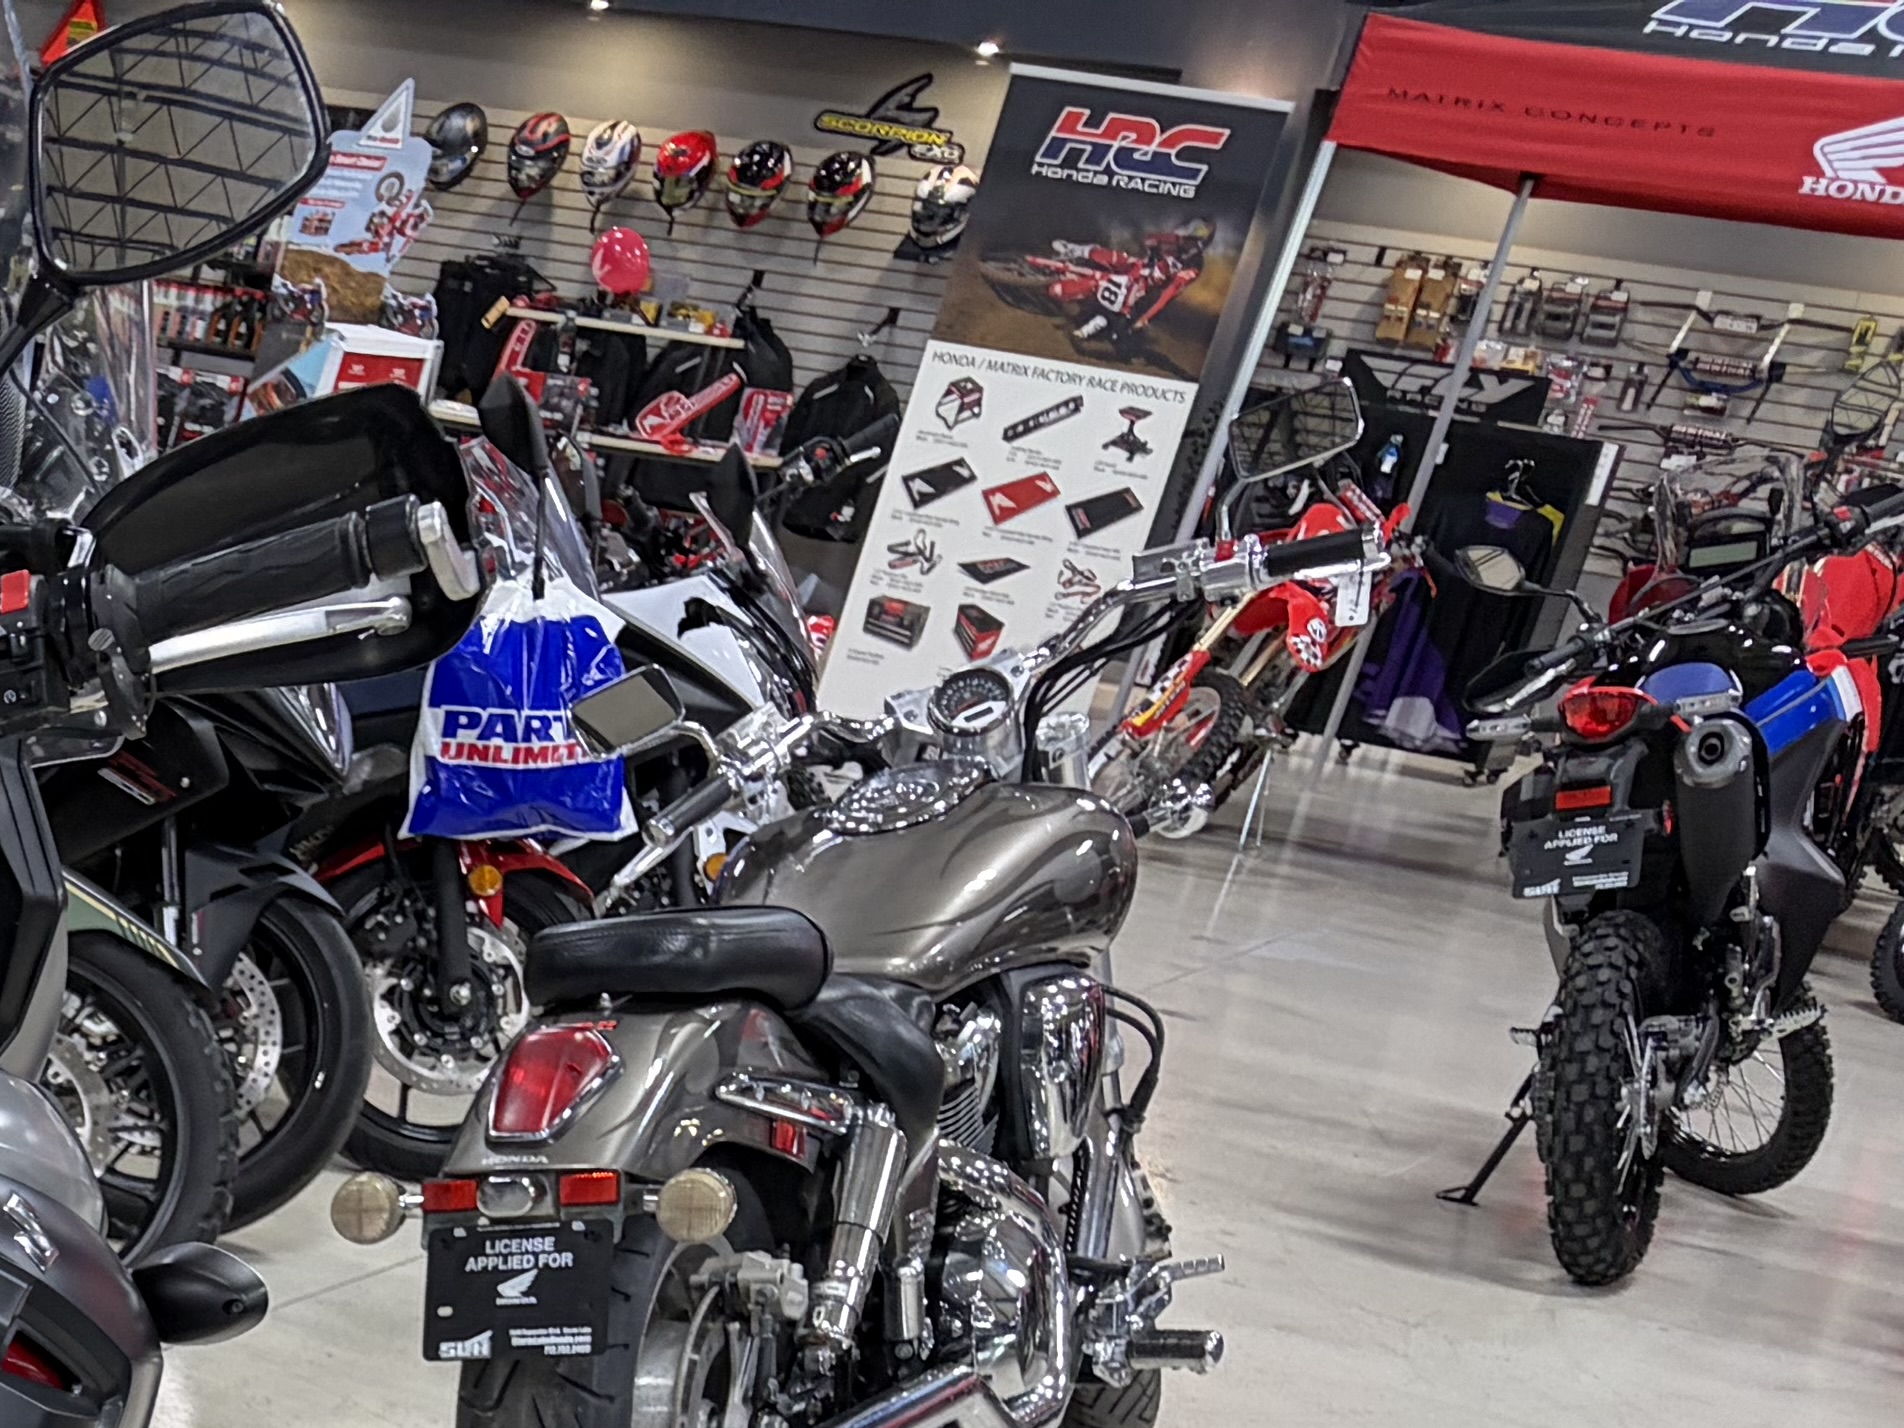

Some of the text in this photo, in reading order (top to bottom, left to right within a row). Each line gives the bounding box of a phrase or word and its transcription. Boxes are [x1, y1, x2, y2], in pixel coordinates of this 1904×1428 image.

[1642, 20, 1876, 56] Honda
[1388, 86, 1505, 113] MATRIX
[819, 114, 950, 147] SCORPION
[1034, 106, 1232, 186] HRC
[1031, 163, 1196, 199] Honda RACING
[1798, 175, 1904, 206] HOND
[931, 349, 976, 369] HONDA
[986, 358, 1030, 379] MATRIX
[1031, 364, 1084, 388] FACTORY
[1086, 373, 1119, 393] RACE
[1119, 381, 1188, 405] PRODUCTS
[442, 709, 565, 746] PAR
[441, 741, 589, 766] UNLIMIT
[481, 1154, 550, 1166] HONDA
[484, 1237, 556, 1255] LICENSE
[464, 1252, 574, 1273] APPLIED FOR
